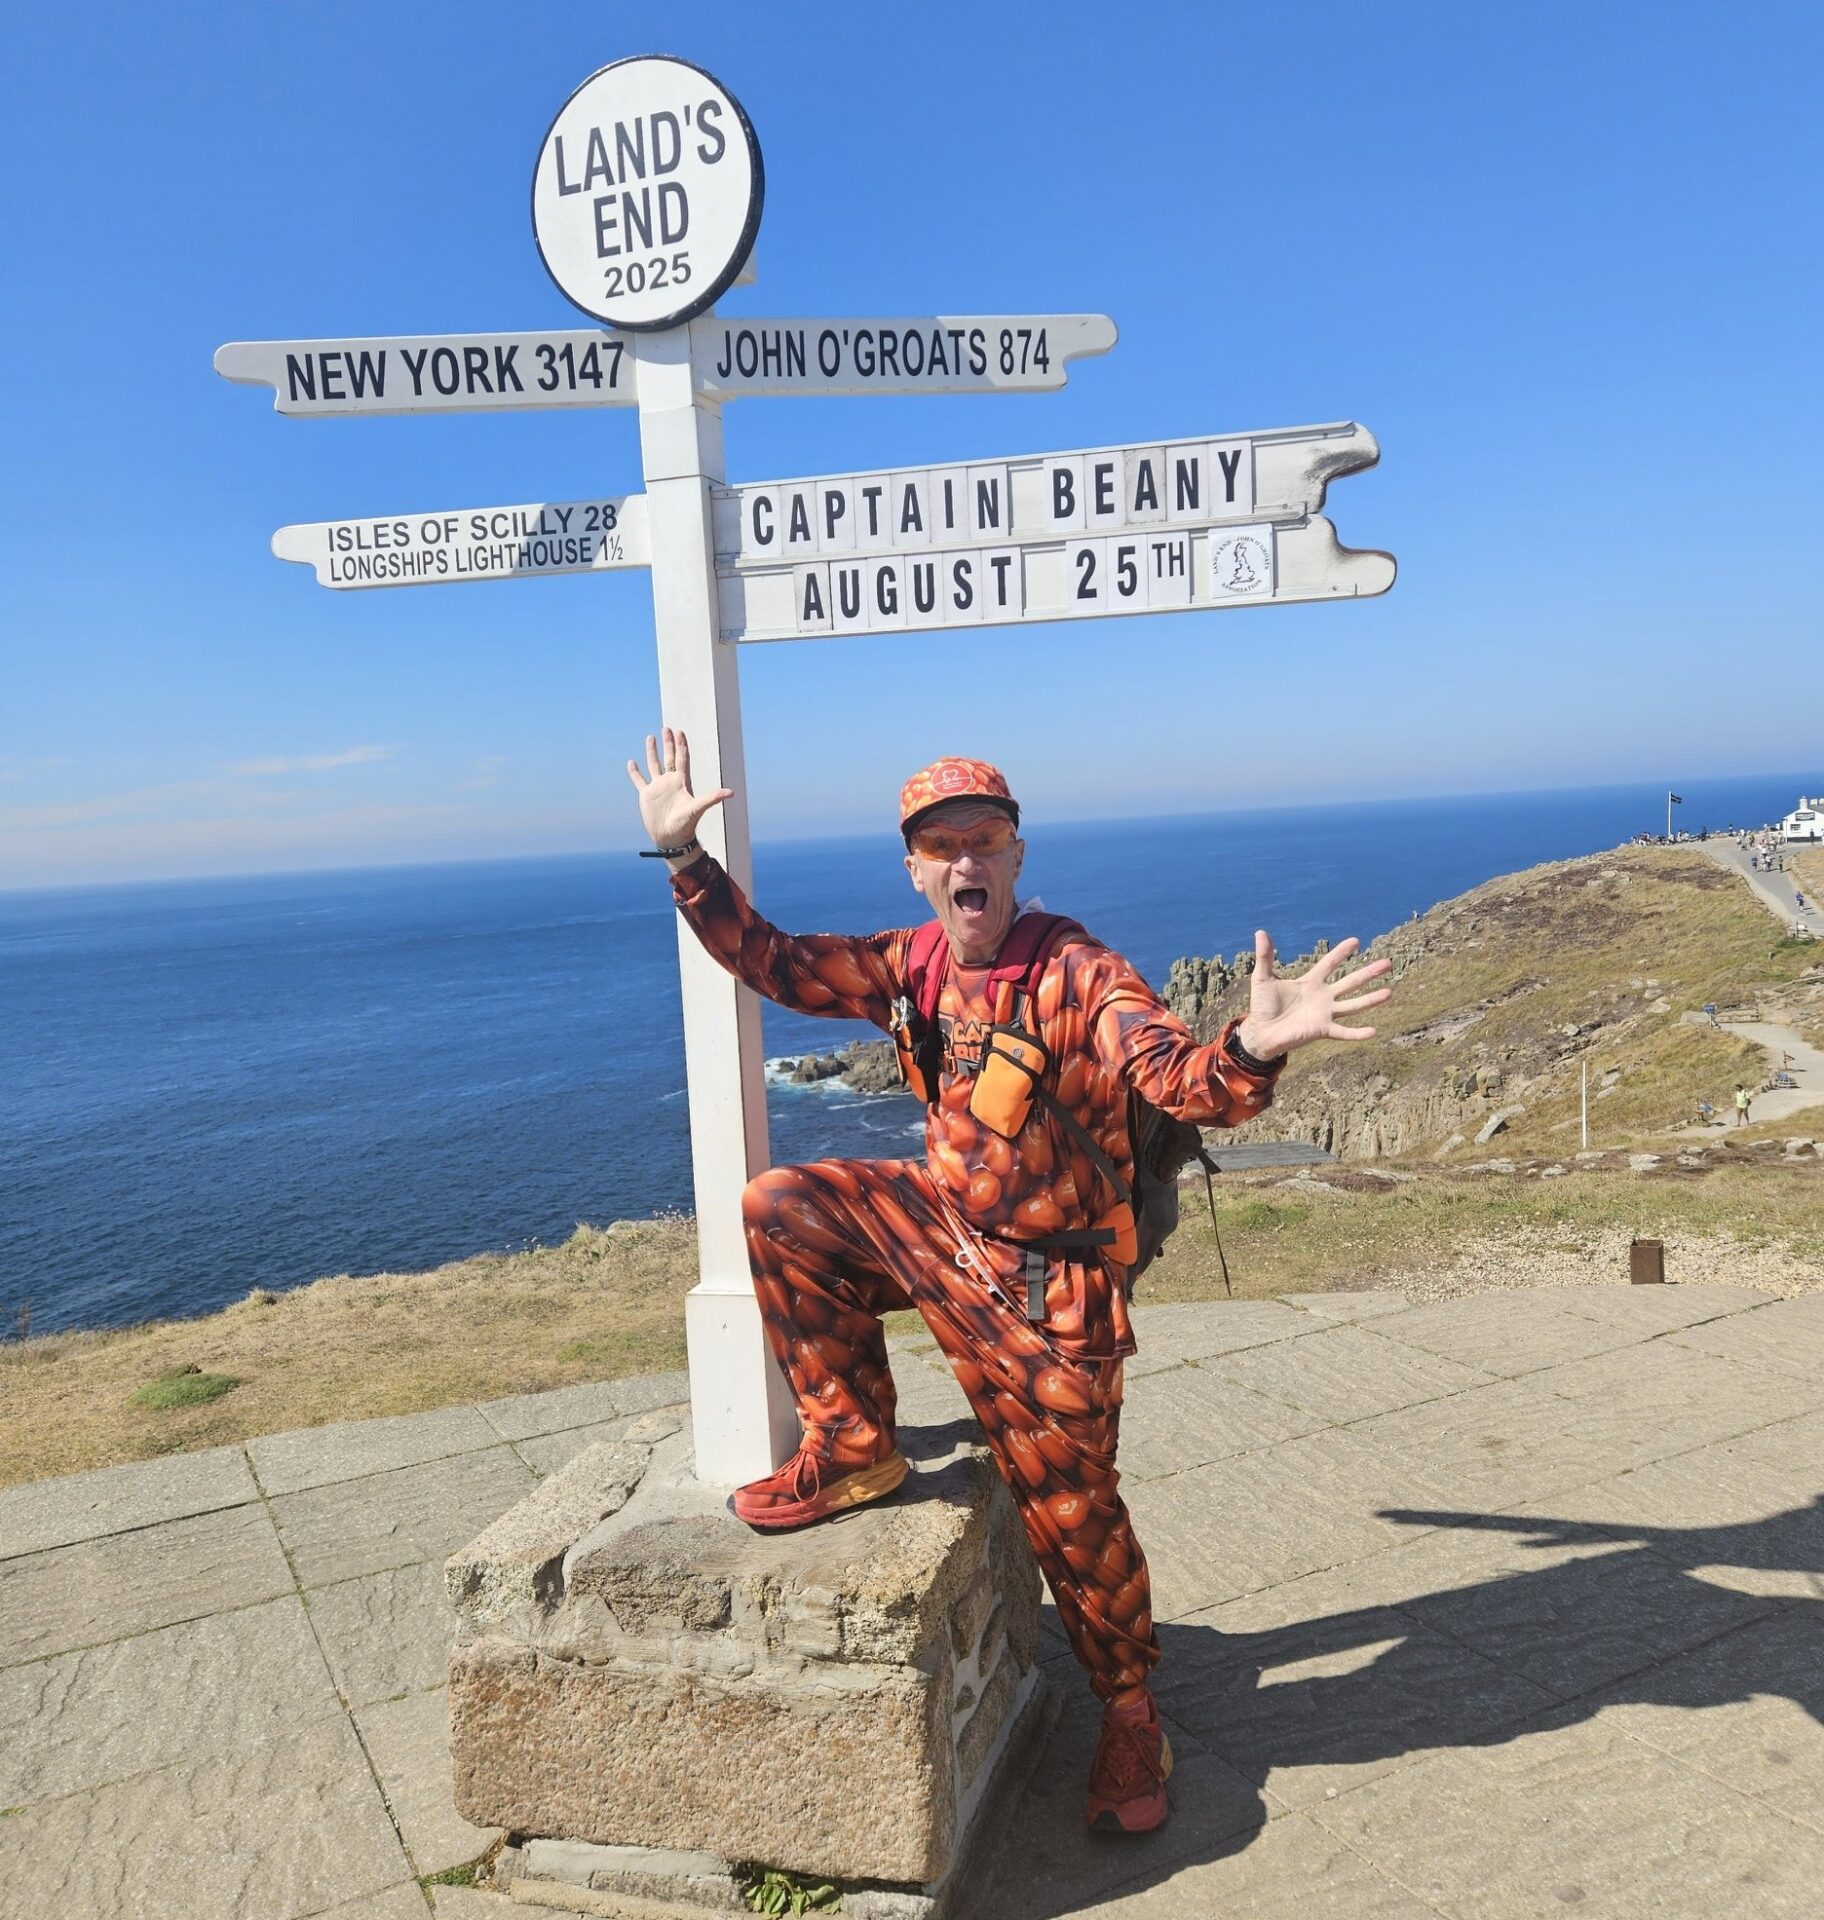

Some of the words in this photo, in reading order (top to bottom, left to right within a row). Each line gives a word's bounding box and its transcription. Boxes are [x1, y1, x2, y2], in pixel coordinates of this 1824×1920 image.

[555, 99, 726, 197] LAND'S
[593, 181, 689, 259] END
[603, 252, 692, 299] 2025
[286, 350, 386, 401] NEW
[400, 345, 525, 396] YORK
[535, 341, 625, 392] 3147
[716, 329, 806, 378] JOHN
[818, 328, 987, 377] O'GROATS
[1000, 328, 1049, 375] 874
[752, 478, 1000, 546] CAPTAIN
[1052, 449, 1242, 519] BEANY
[327, 523, 410, 552] ISLES
[420, 517, 459, 544] OF
[470, 507, 574, 541] SCILLY
[584, 504, 618, 532] 28
[330, 548, 448, 582] LONGSHIPS
[456, 536, 593, 573] LIGHTHOUSE
[803, 556, 1012, 621] AUGUST
